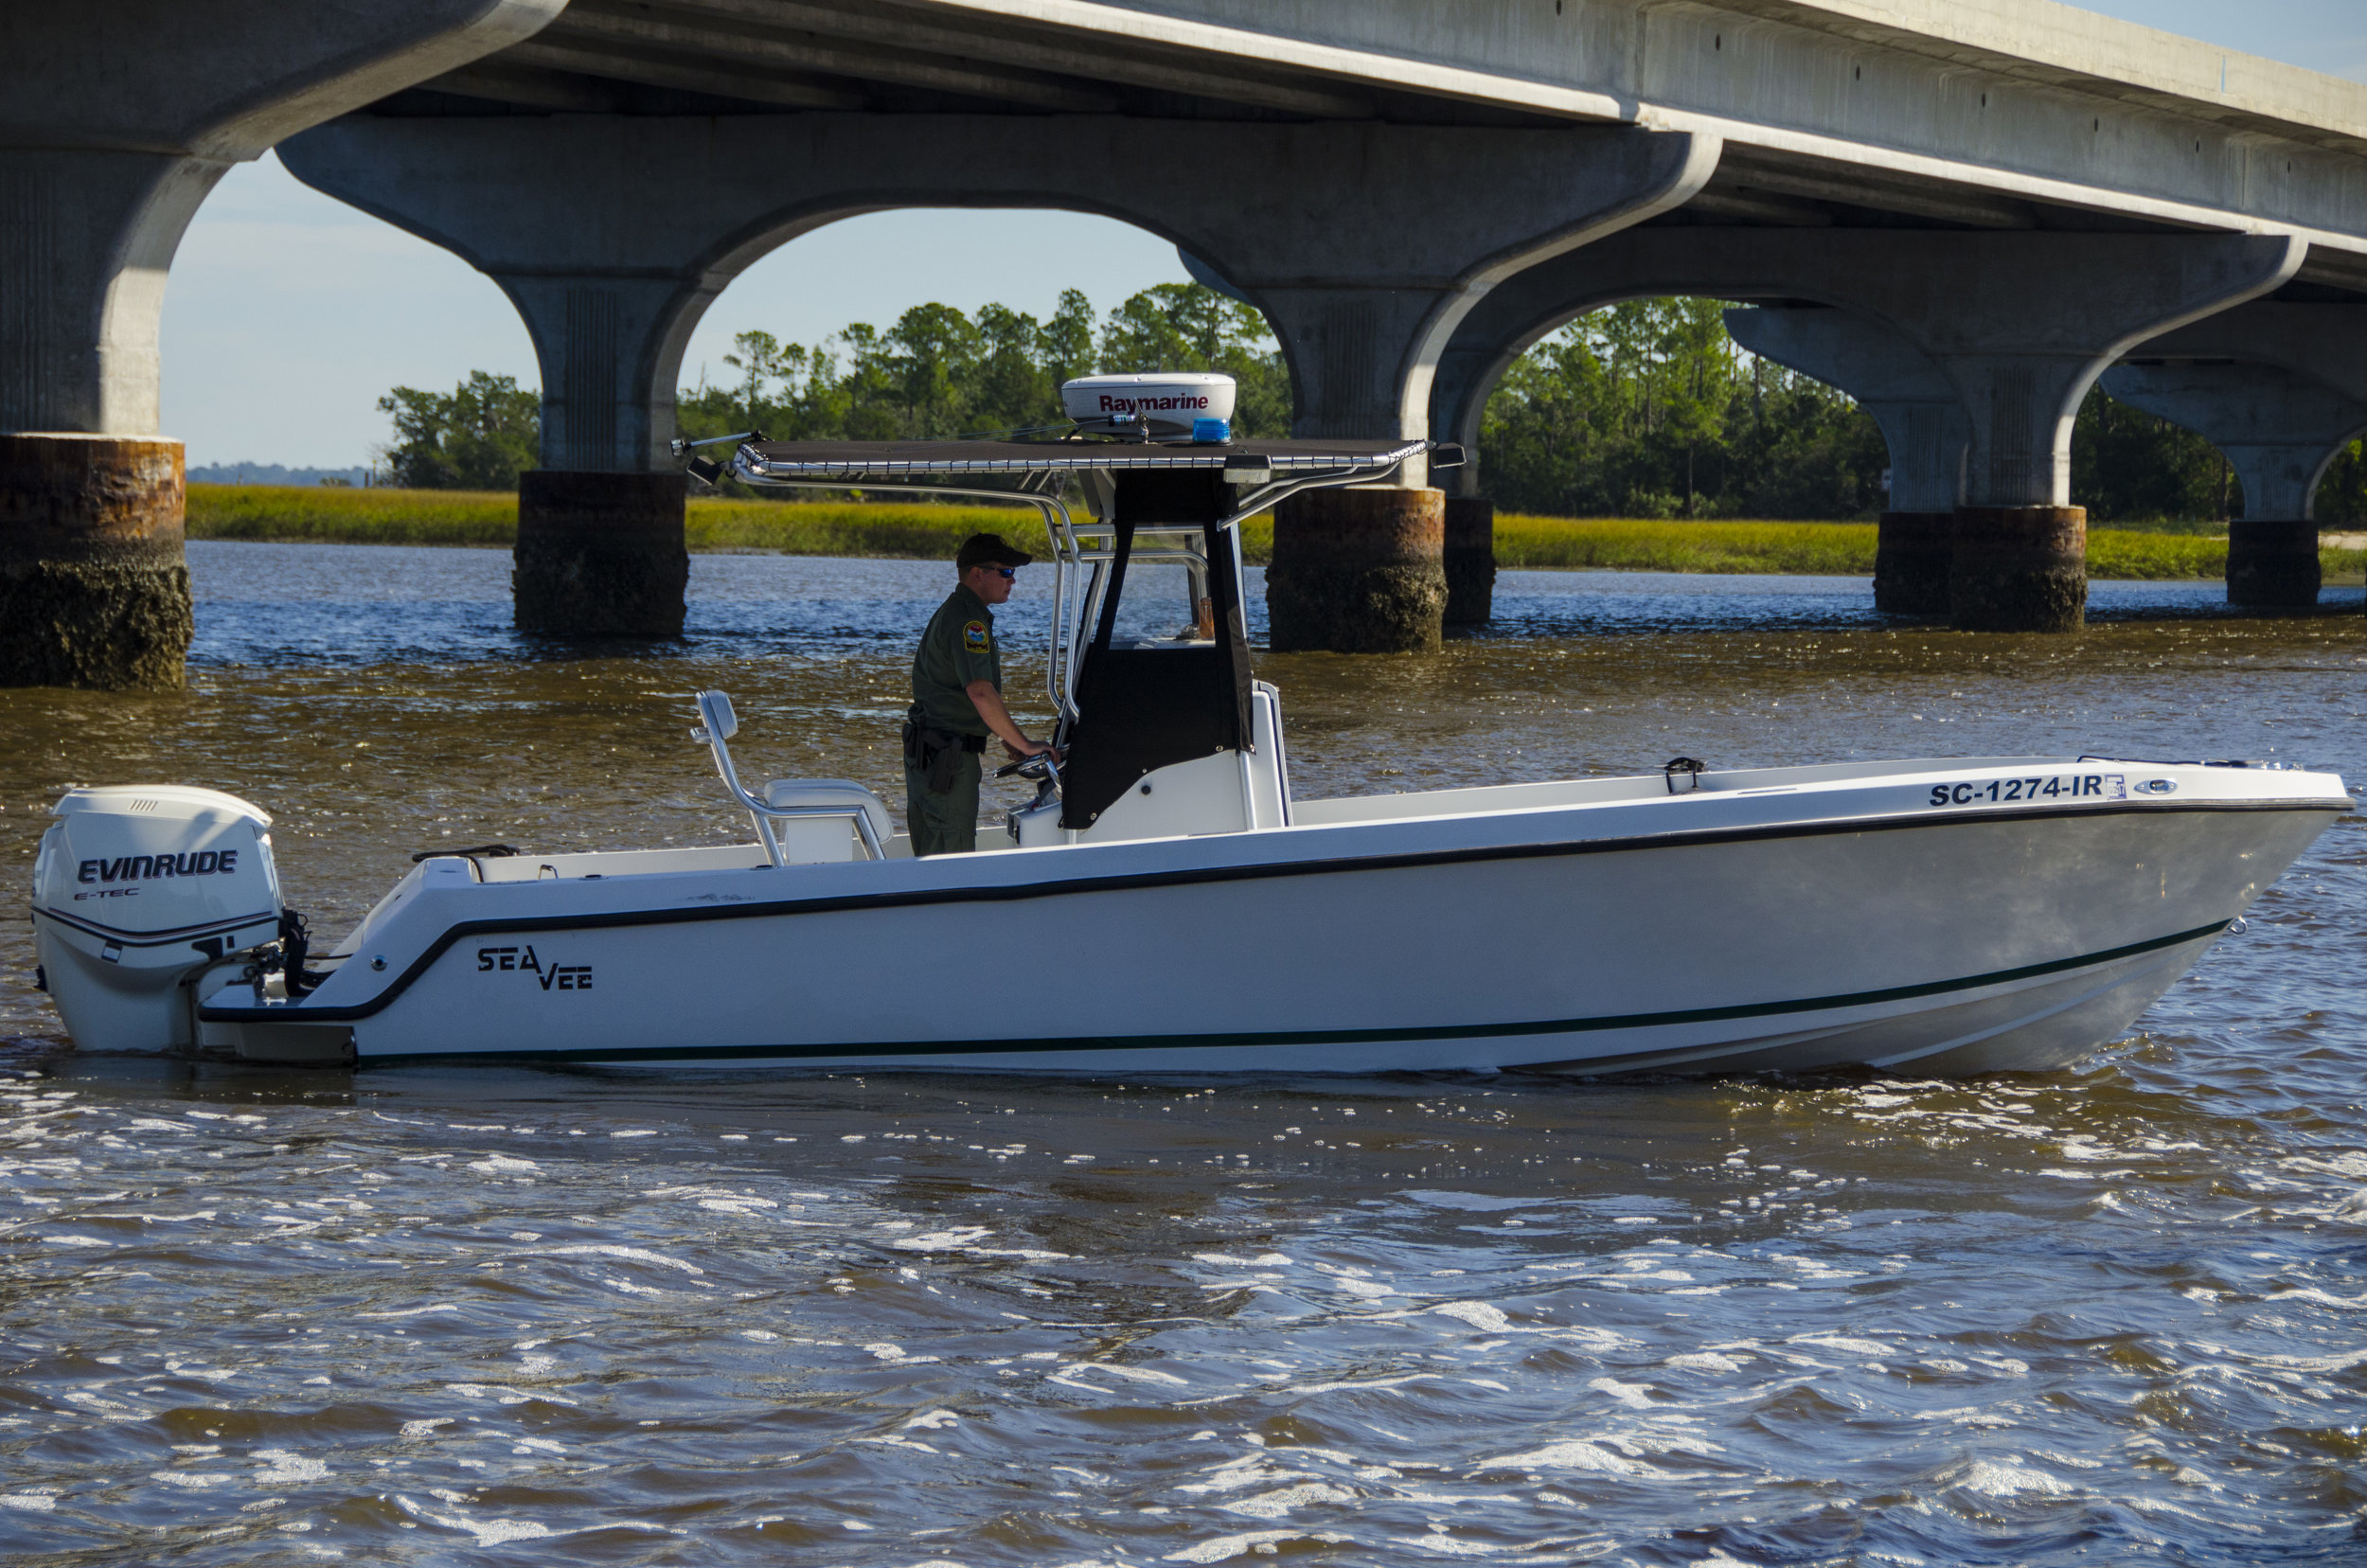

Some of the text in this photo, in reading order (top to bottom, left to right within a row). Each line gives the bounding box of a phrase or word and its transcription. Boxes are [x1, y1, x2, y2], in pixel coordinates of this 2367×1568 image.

[1099, 392, 1209, 415] Raymarine
[1930, 775, 2102, 807] SC-1274-IR
[77, 849, 238, 884] EVINRUDE
[74, 887, 140, 900] E-TEC
[477, 945, 593, 991] SEA VEE
